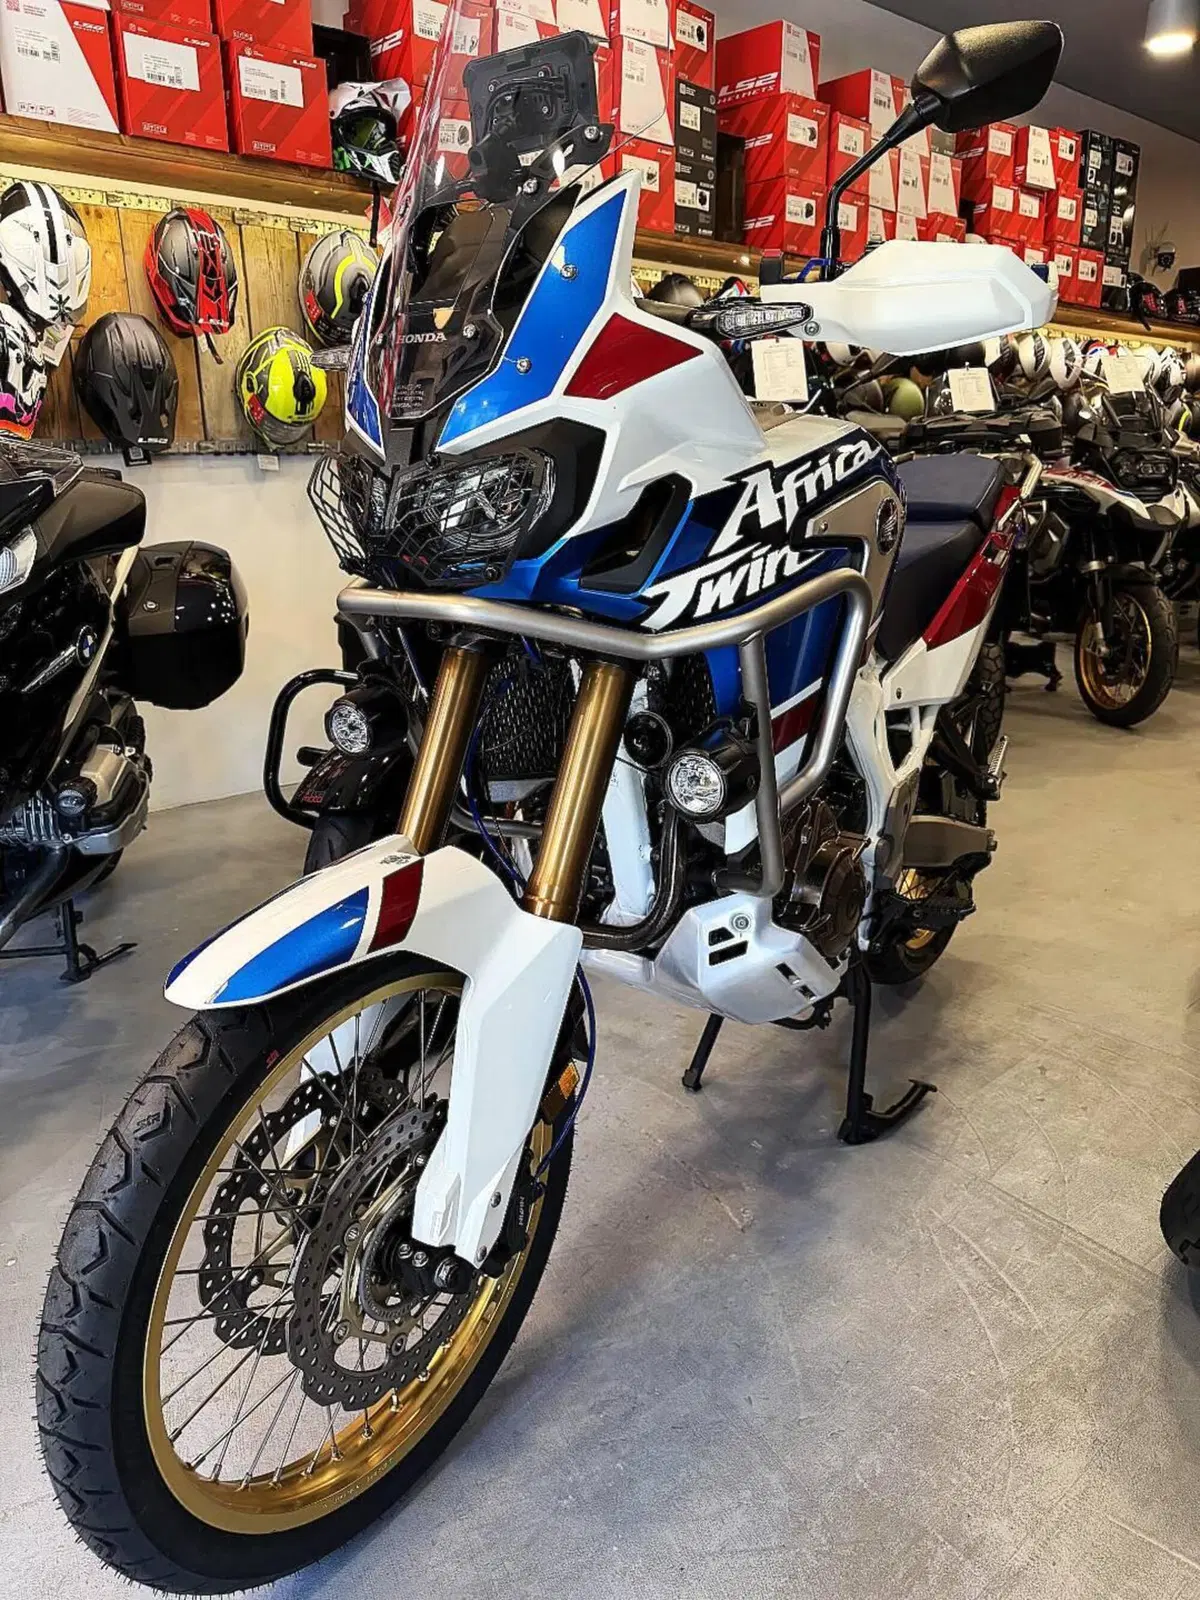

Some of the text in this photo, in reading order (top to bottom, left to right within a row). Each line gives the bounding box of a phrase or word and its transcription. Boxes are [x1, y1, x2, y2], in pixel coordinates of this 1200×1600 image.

[370, 29, 404, 57] S2
[718, 72, 779, 97] LS2
[744, 133, 774, 150] S2
[742, 215, 776, 230] S2
[396, 332, 448, 344] HONDA
[708, 440, 881, 557] Africa
[640, 542, 826, 631] Twin
